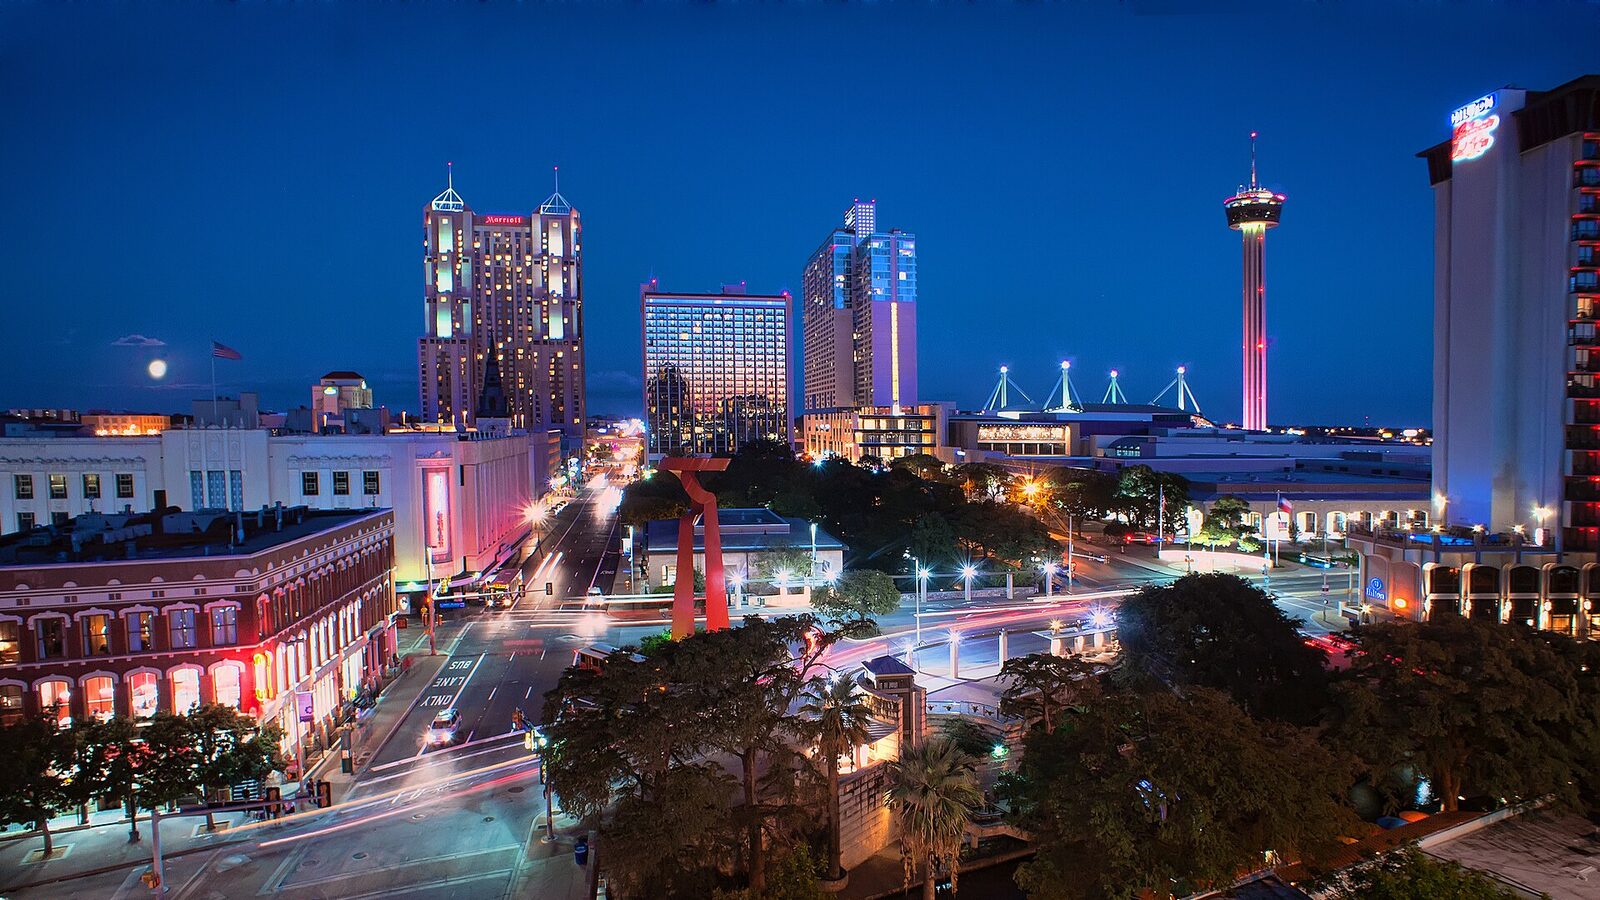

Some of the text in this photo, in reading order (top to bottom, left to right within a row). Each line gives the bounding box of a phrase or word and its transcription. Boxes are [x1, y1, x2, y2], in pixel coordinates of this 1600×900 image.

[485, 216, 521, 224] Marriott
[1366, 587, 1385, 600] Hilton
[449, 660, 472, 670] BUS
[433, 676, 466, 688] LANE
[420, 694, 453, 707] ONLY
